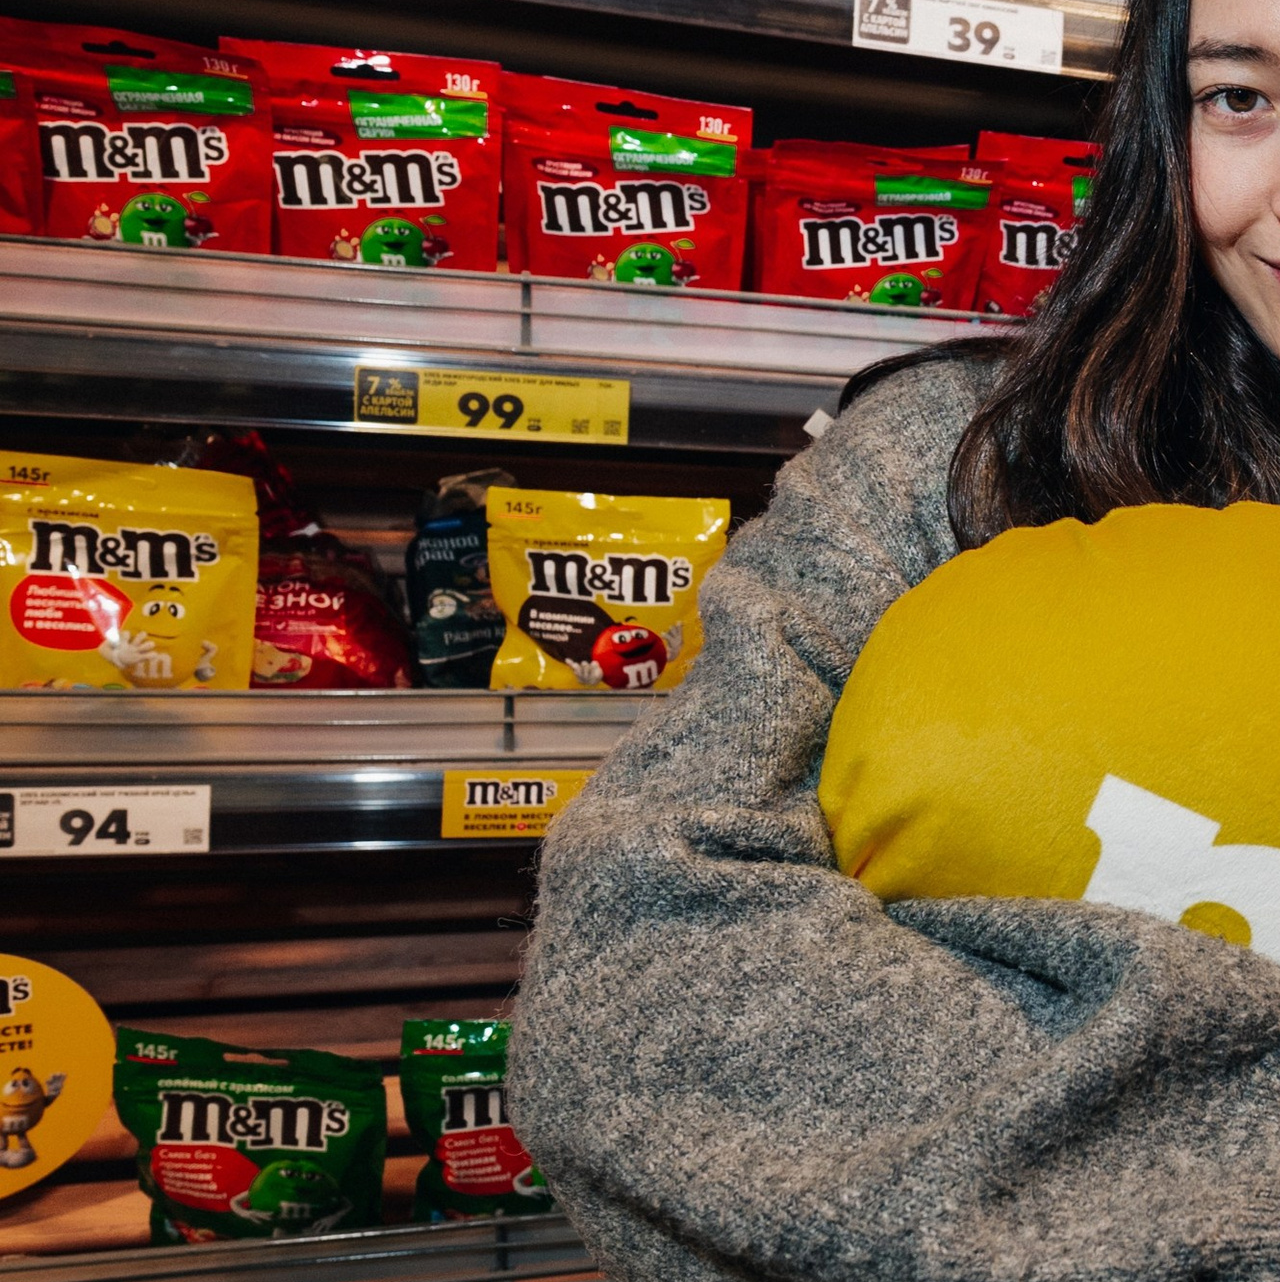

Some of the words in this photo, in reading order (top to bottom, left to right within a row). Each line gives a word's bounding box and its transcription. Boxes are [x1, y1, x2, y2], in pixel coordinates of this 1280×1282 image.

[947, 16, 1001, 56] 39
[38, 120, 229, 183] m&m's
[273, 148, 462, 209] m&m's
[537, 179, 711, 237] m&m's
[799, 213, 959, 270] m&m's
[366, 375, 380, 395] 7
[371, 396, 412, 407] КАРТОЙ
[360, 405, 415, 417] АПЕЛЬСИН
[458, 391, 525, 430] 99
[8, 465, 51, 483] 145г
[504, 501, 544, 516] 145г
[28, 518, 219, 582] m&m's
[525, 548, 693, 607] m&m's
[59, 807, 131, 847] 94
[135, 1042, 178, 1061] 145г
[157, 1089, 350, 1152] m&m's
